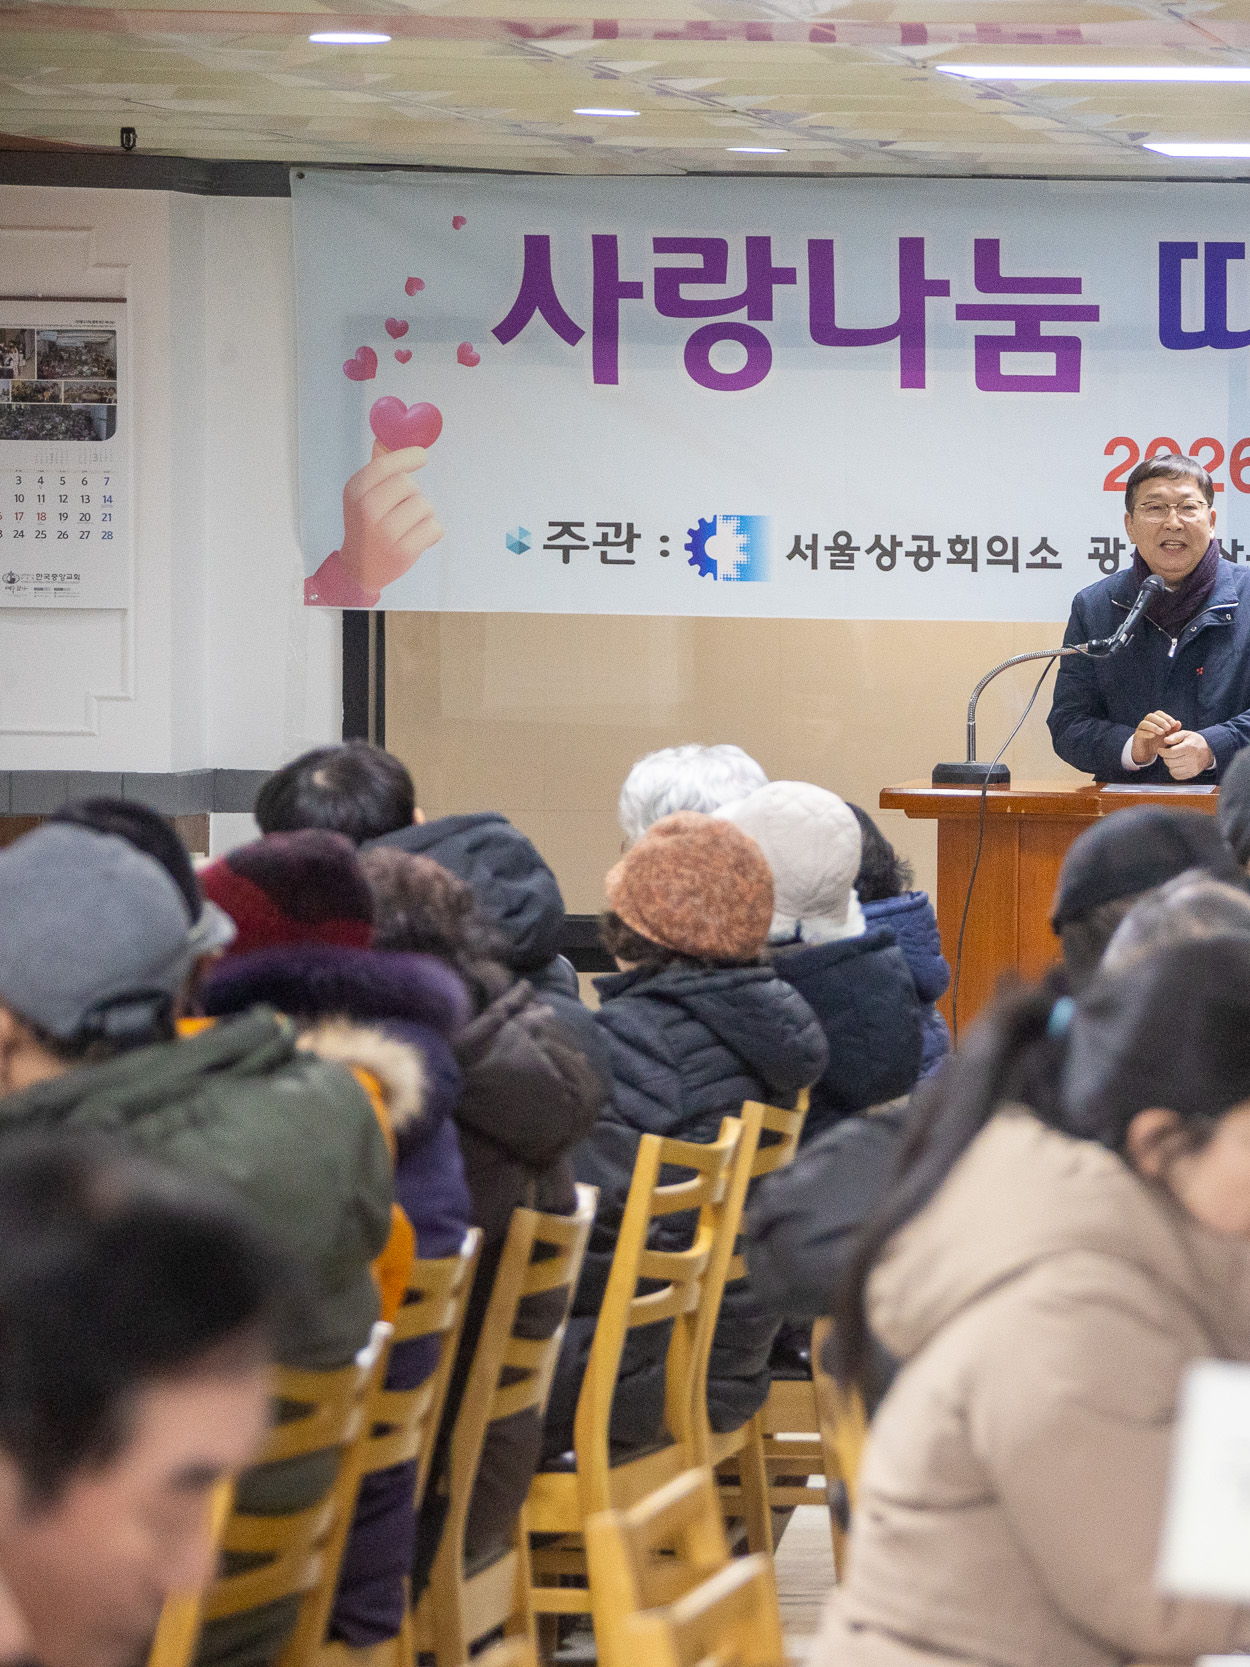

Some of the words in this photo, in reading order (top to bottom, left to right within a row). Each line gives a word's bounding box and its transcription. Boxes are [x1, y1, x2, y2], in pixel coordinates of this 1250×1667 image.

[491, 234, 1100, 393] 사랑나눔
[15, 475, 22, 485] 3
[37, 476, 44, 485] 4
[59, 476, 66, 486] 5
[81, 476, 88, 486] 6
[103, 476, 110, 486] 7
[14, 493, 25, 503] 10
[37, 494, 46, 503] 11
[59, 494, 69, 504] 12
[80, 494, 91, 504] 13
[102, 495, 113, 504] 14
[14, 511, 24, 521] 17
[36, 511, 47, 521] 18
[58, 512, 69, 521] 19
[79, 512, 91, 522] 20
[101, 513, 112, 522] 21
[13, 529, 25, 539] 24
[35, 529, 47, 539] 25
[57, 530, 69, 539] 26
[79, 530, 91, 540] 27
[101, 530, 114, 540] 28
[542, 521, 641, 565] 주관
[786, 530, 1063, 573] 서울상공회의소
